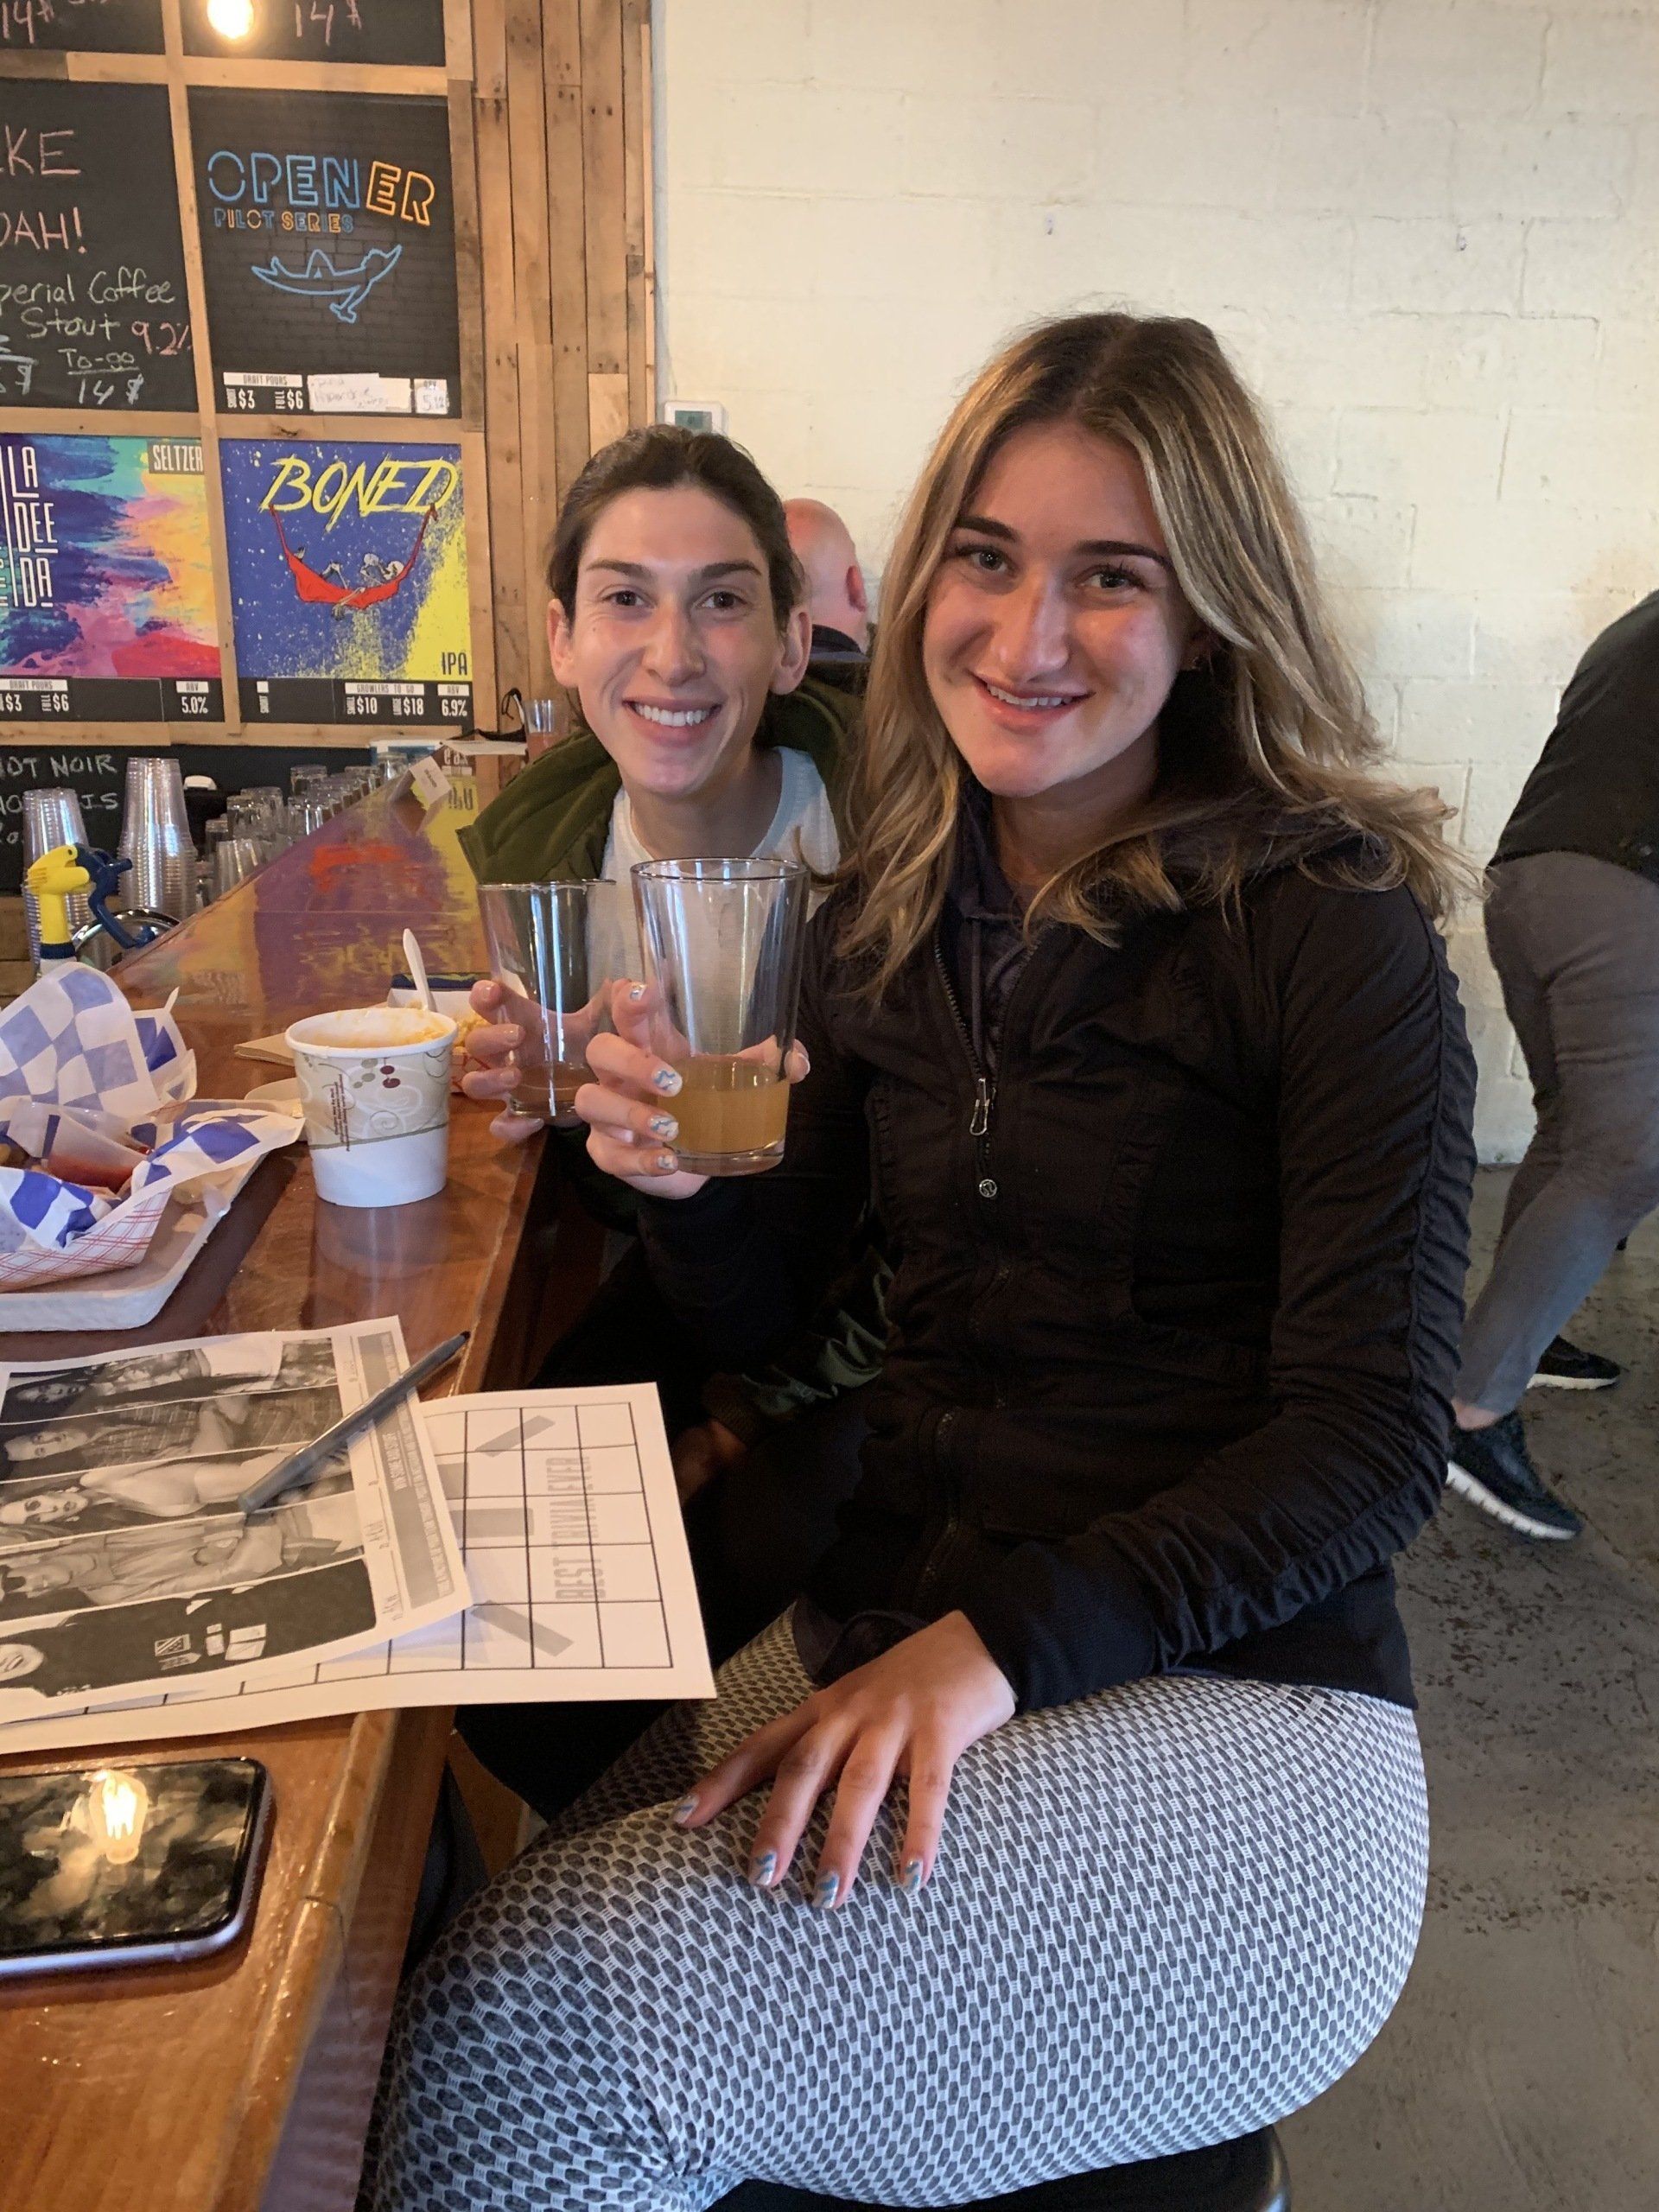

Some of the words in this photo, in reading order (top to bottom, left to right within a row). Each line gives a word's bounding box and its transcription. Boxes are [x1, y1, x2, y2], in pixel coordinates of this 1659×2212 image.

[0, 125, 81, 176] KE
[207, 150, 435, 226] OPENER
[213, 207, 274, 229] PILOT
[282, 211, 354, 233] SERIES
[88, 266, 175, 303] Coffee
[21, 307, 121, 340] Stout
[238, 388, 256, 410] $3
[287, 388, 304, 410] $6
[152, 444, 204, 472] SELTZER
[258, 452, 459, 534] BONED
[442, 651, 468, 676] IPA
[5, 694, 22, 713] $3
[53, 694, 70, 712] $6
[181, 695, 209, 714] 5.0%
[356, 696, 378, 715] $10
[403, 696, 425, 716] $18
[441, 699, 468, 717] 6.9%
[50, 753, 118, 778] NOIR
[544, 1456, 594, 1492] EVER
[552, 1556, 607, 1599] BEST
